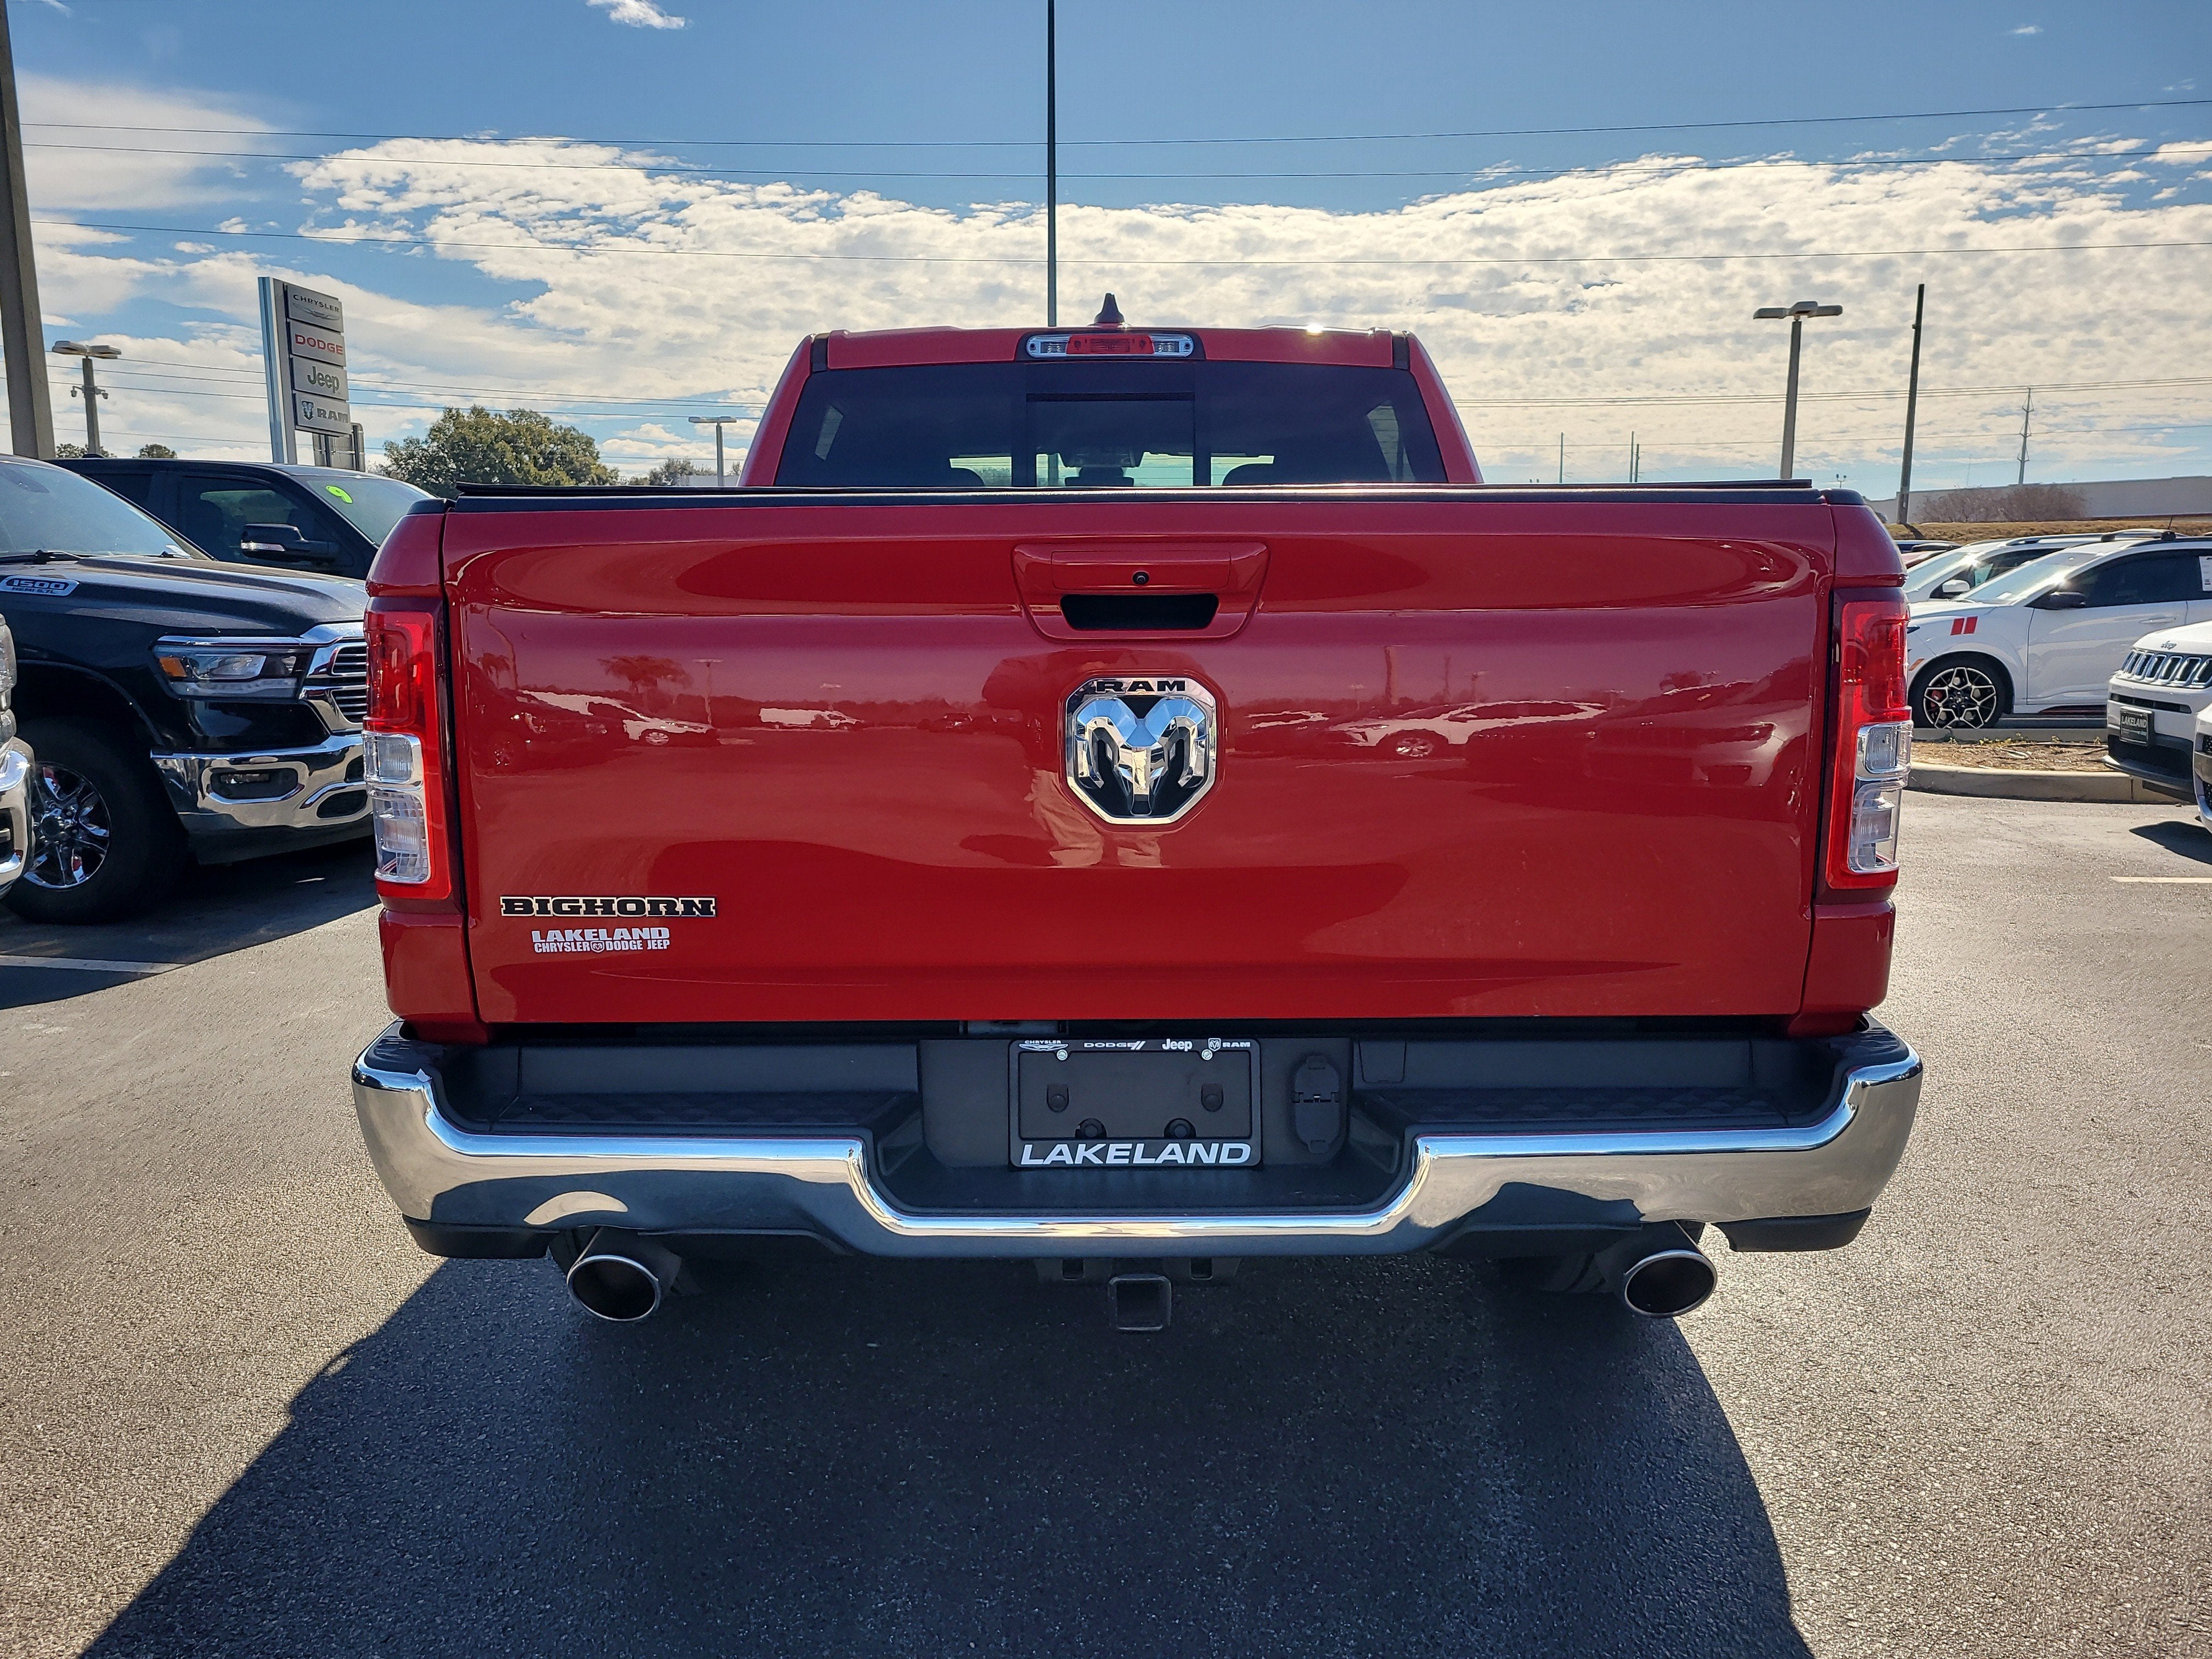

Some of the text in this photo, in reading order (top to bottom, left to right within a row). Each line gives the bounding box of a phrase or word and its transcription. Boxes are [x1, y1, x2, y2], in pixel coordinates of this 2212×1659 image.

[293, 294, 340, 313] CHRYSLER
[295, 334, 343, 355] DODGE
[307, 366, 340, 393] Jeep
[317, 408, 349, 424] RAM
[13, 579, 65, 589] 1500
[1097, 680, 1186, 692] RAM
[2121, 715, 2147, 728] LAKELAND
[500, 896, 716, 917] BIGHORN
[532, 927, 670, 943] LAKELAND
[534, 939, 670, 953] CHRYSLER DODGE JEEP
[1162, 1039, 1193, 1052] Jeep
[1020, 1143, 1251, 1165] LAKELAND
